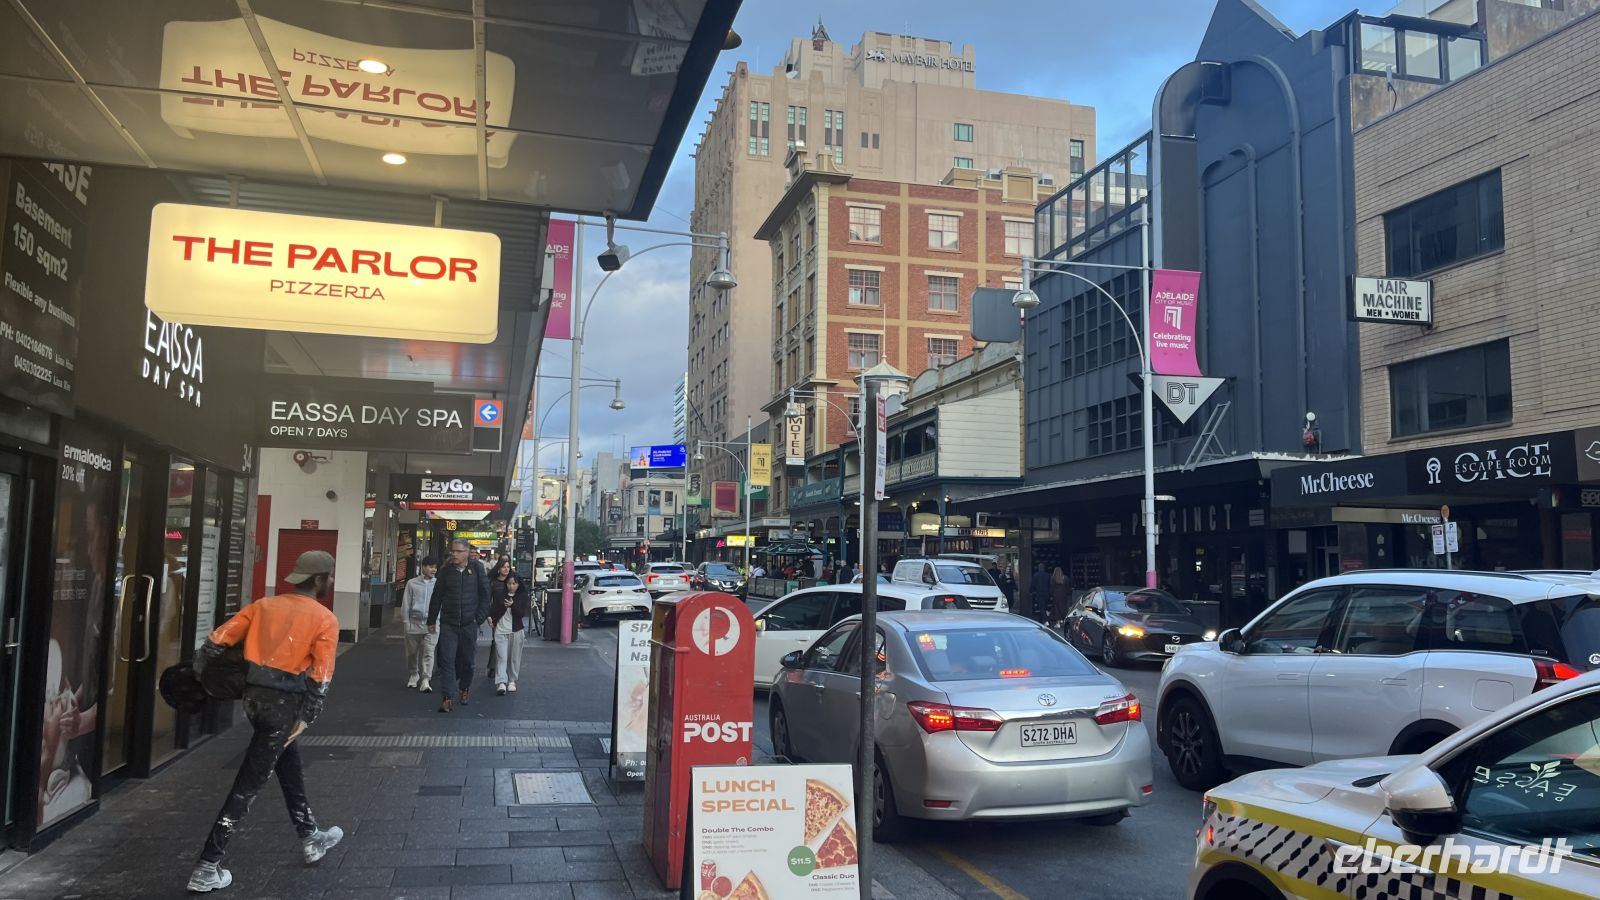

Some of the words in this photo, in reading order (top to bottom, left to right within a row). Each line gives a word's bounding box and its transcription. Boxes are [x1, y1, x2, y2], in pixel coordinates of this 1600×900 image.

[892, 52, 939, 69] MAYFAIR
[941, 58, 975, 72] HOTEL
[16, 182, 72, 249] Basement
[13, 222, 34, 257] 150
[36, 246, 68, 281] sqm2
[172, 235, 274, 267] THE
[287, 243, 479, 283] PARLOR
[270, 279, 385, 300] PIZZERIA
[1155, 291, 1195, 301] ADELAIDE
[1376, 279, 1408, 295] HAIR
[4, 272, 33, 302] Flexible
[34, 294, 47, 313] any
[48, 300, 75, 328] business
[1363, 293, 1422, 311] MACHINE
[1367, 309, 1382, 317] MEN
[1391, 310, 1420, 320] WOMEN
[0, 320, 14, 340] PH:
[1153, 332, 1191, 343] Celebrating
[142, 358, 170, 389] DAY
[180, 380, 201, 408] SPA
[1166, 381, 1199, 405] DT
[271, 400, 355, 423] EASSA
[361, 405, 410, 425] DAY
[416, 408, 463, 428] SPA
[270, 425, 304, 437] OPEN
[307, 427, 314, 437] 7
[317, 427, 348, 438] DAYS
[788, 416, 803, 456] MOTEL
[64, 444, 112, 472] ermalogica
[242, 443, 252, 473] 34
[1455, 460, 1502, 473] ESCAPE
[1509, 455, 1551, 468] ROOM
[62, 464, 75, 482] 20%
[76, 469, 85, 483] off
[421, 478, 474, 494] EzyGo
[1301, 472, 1374, 495] Mr.Cheese
[393, 493, 409, 501] 24/7
[1132, 503, 1232, 536] PECINCT
[1401, 513, 1441, 524] Mr.Cheese
[458, 531, 493, 539] SUBWAY
[631, 652, 650, 661] Na
[683, 721, 753, 743] POST
[1023, 728, 1049, 742] S272
[1053, 726, 1075, 740] DHA
[702, 779, 776, 794] LUNCH
[702, 798, 795, 813] SPECIAL
[790, 857, 812, 865] $11.5
